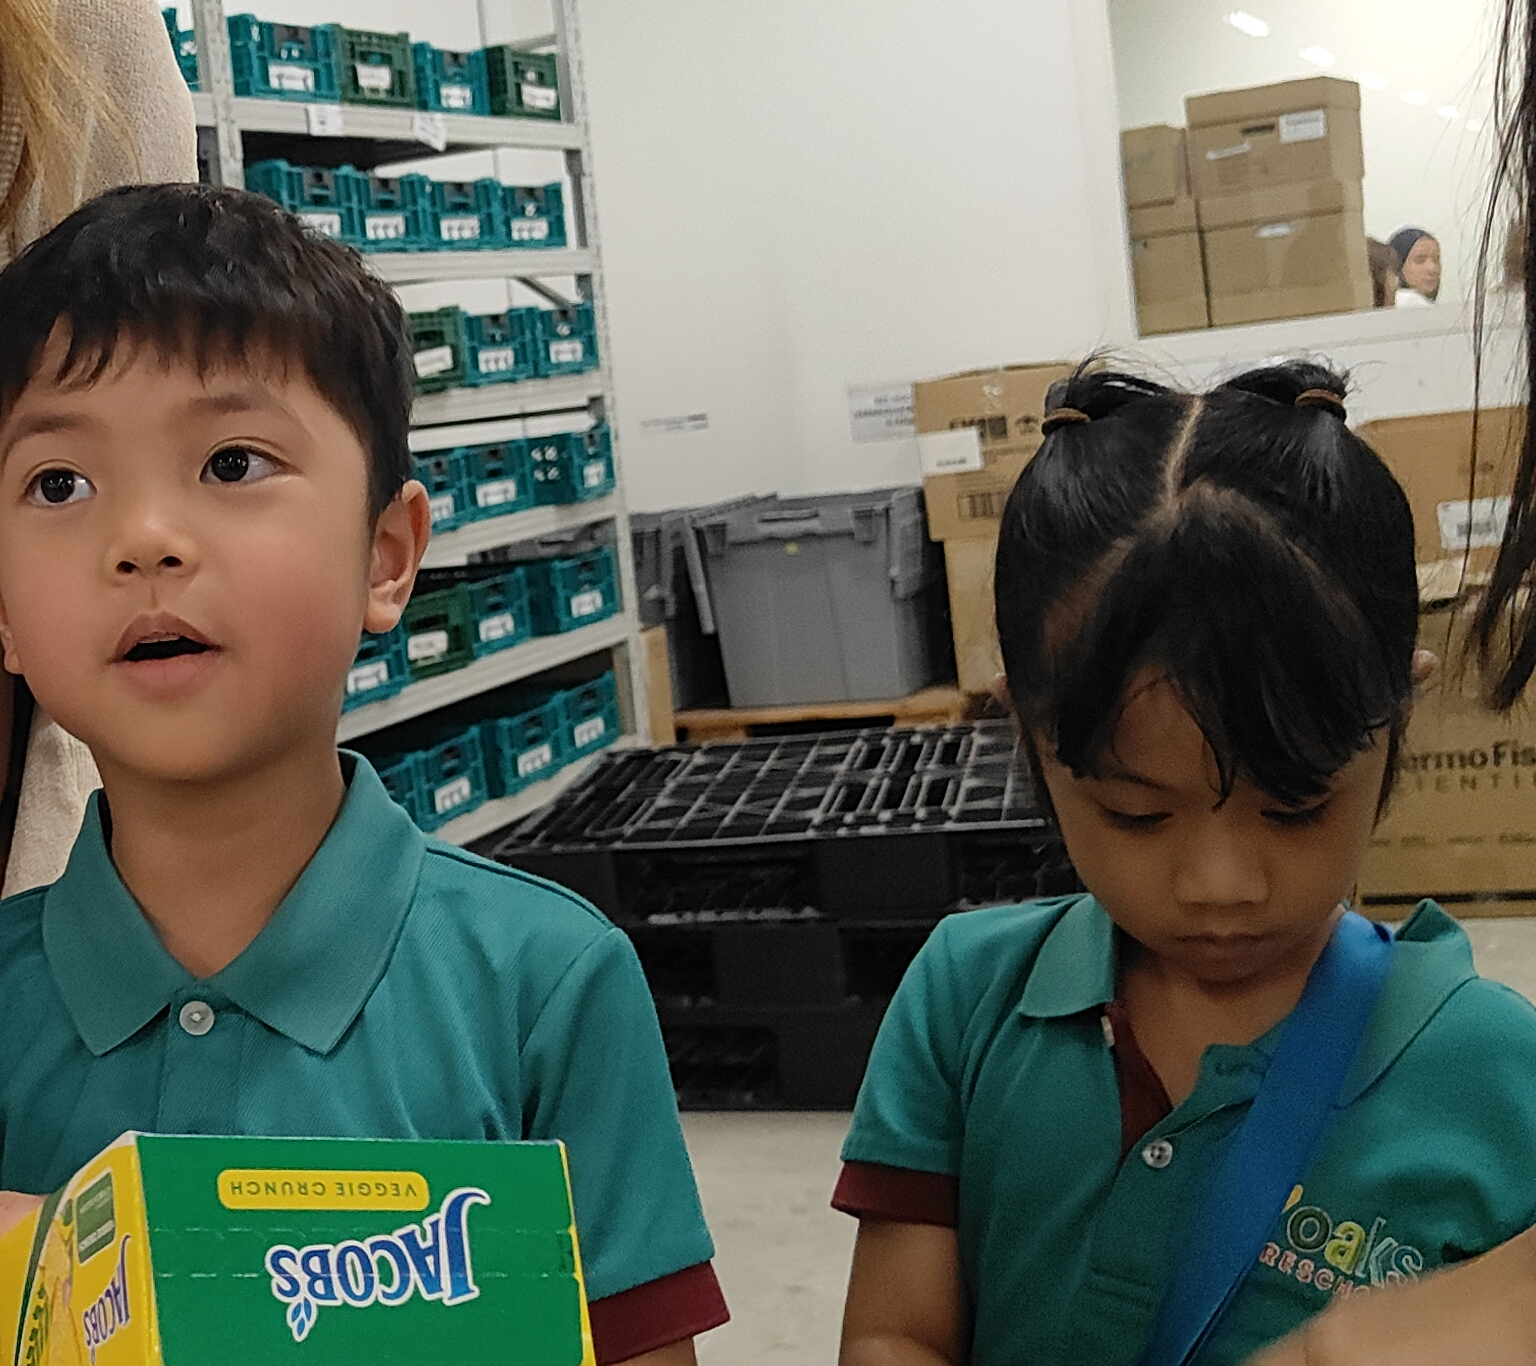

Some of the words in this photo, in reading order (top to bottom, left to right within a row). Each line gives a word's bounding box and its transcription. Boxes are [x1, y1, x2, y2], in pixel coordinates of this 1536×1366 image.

[230, 1180, 325, 1196] CRUNCH
[336, 1182, 417, 1197] VEGGIE
[1259, 1242, 1371, 1299] RESCH
